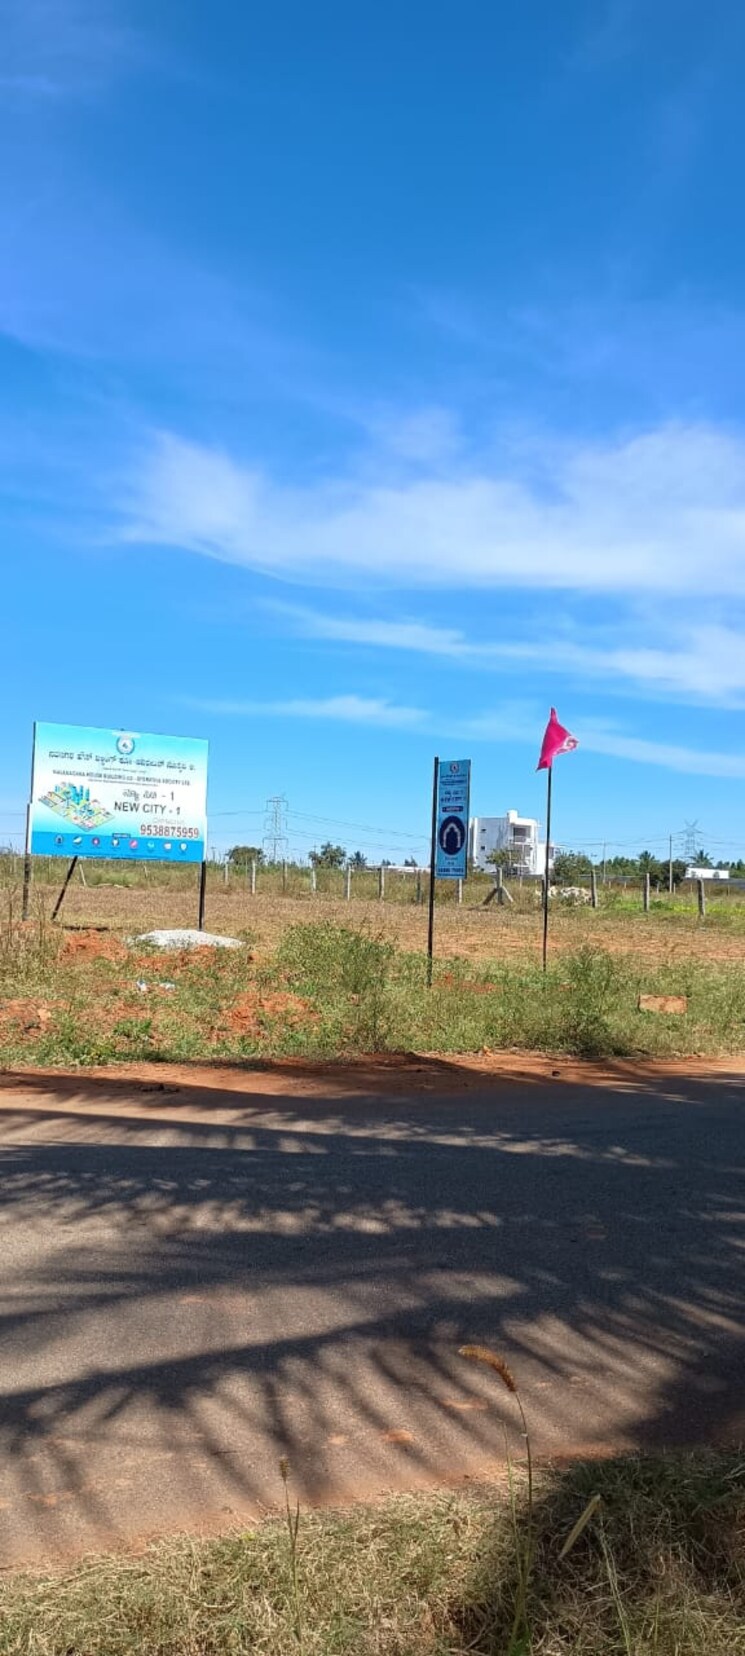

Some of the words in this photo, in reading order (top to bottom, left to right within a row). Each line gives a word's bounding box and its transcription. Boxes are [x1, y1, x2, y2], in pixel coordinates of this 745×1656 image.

[170, 791, 174, 801] 1
[114, 801, 140, 813] NEW
[142, 803, 167, 814] CITY
[175, 807, 181, 815] 1
[140, 823, 200, 839] 9538875959
